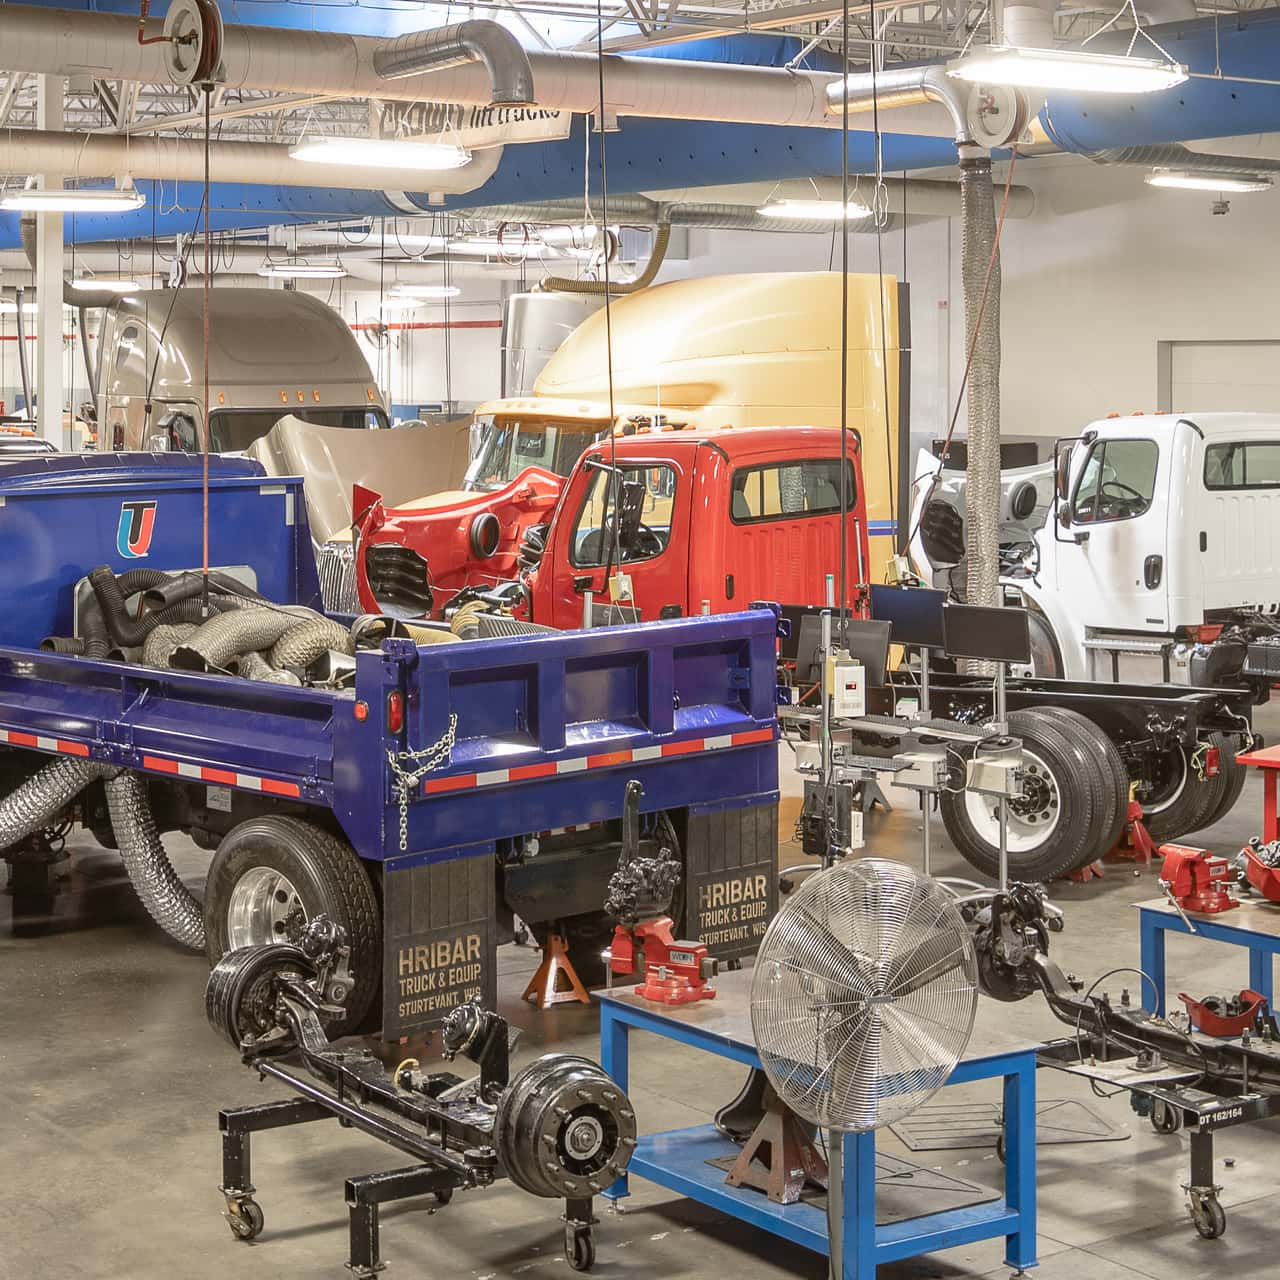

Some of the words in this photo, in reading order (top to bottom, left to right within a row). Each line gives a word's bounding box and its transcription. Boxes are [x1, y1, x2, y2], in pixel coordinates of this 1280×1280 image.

[698, 875, 767, 910] HRIBAR
[698, 907, 730, 929] TRUCK
[731, 907, 739, 922] &
[399, 934, 481, 976] HRIBAR
[399, 971, 436, 997] TRUCK
[438, 972, 446, 988] &
[1212, 1106, 1243, 1122] 162/164
